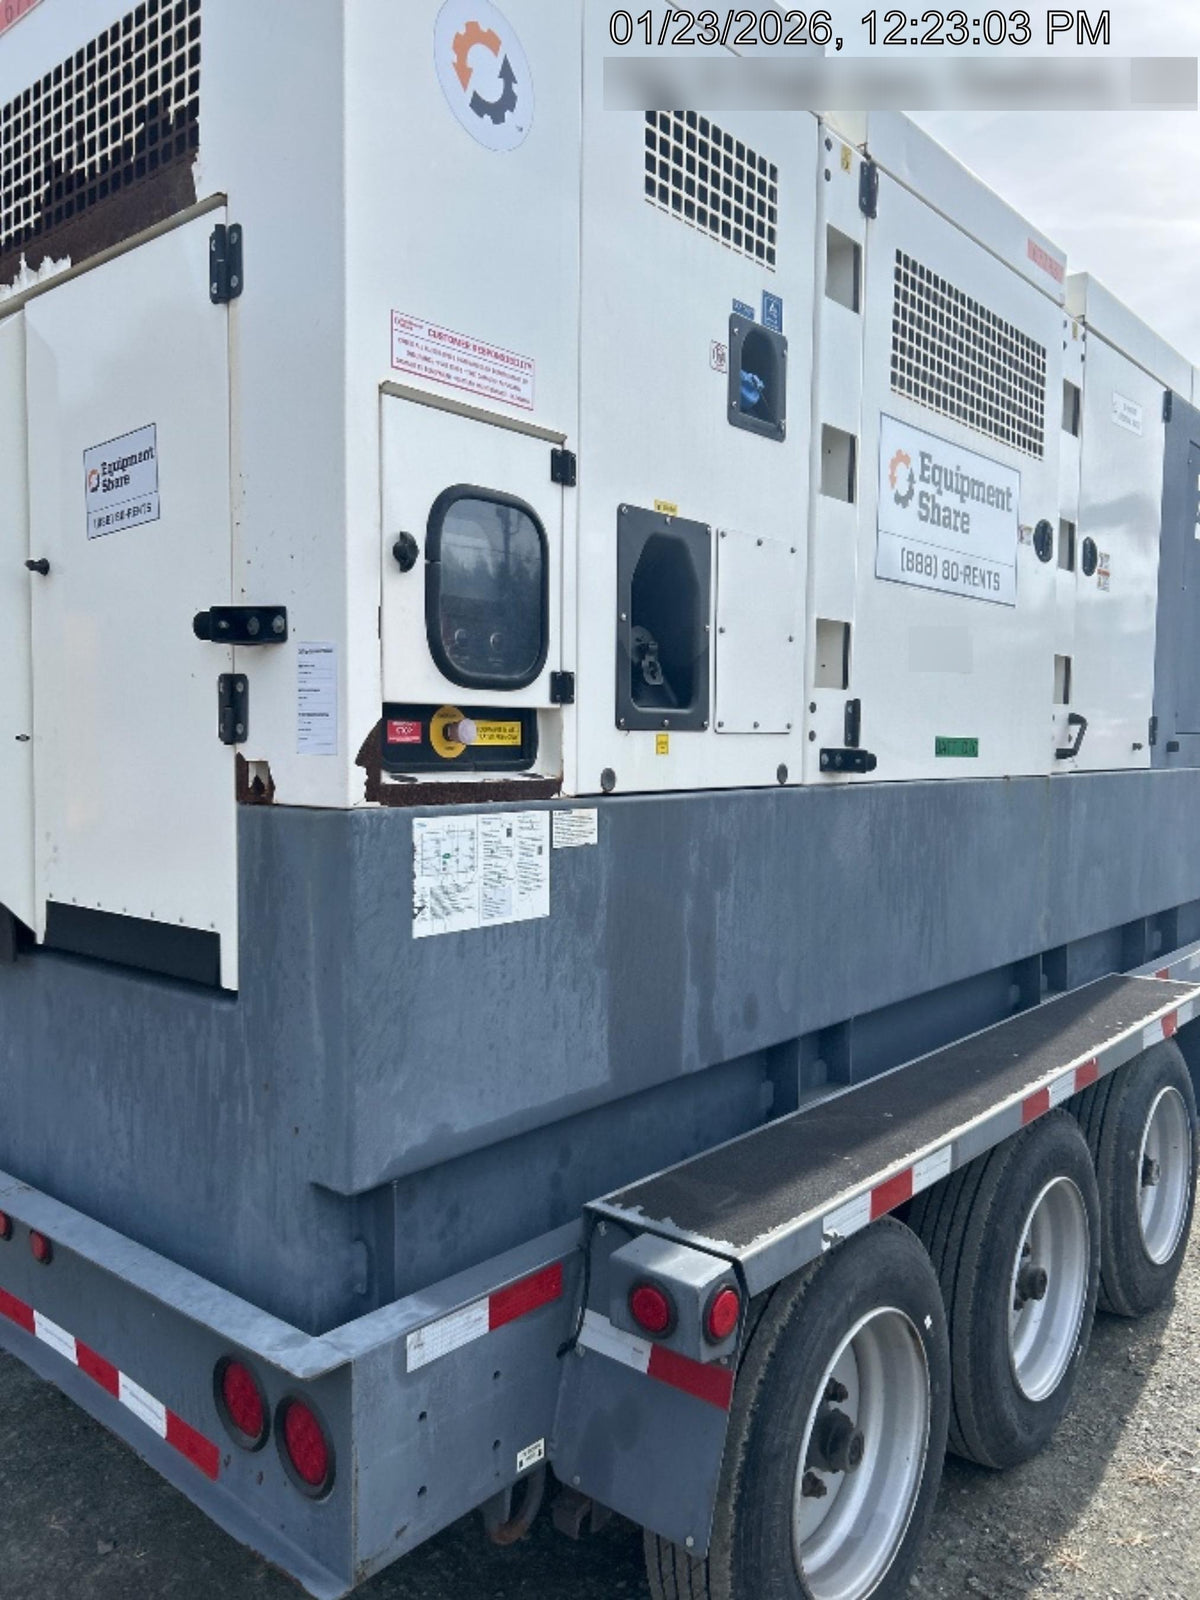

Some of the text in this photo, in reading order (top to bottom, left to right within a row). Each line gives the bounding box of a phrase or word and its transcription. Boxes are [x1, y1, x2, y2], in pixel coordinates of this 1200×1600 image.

[101, 446, 155, 477] Equipment
[102, 474, 131, 493] Share
[918, 451, 1013, 513] Equipment
[917, 490, 970, 534] Share
[901, 547, 1001, 591] (888) 80-RENTS
